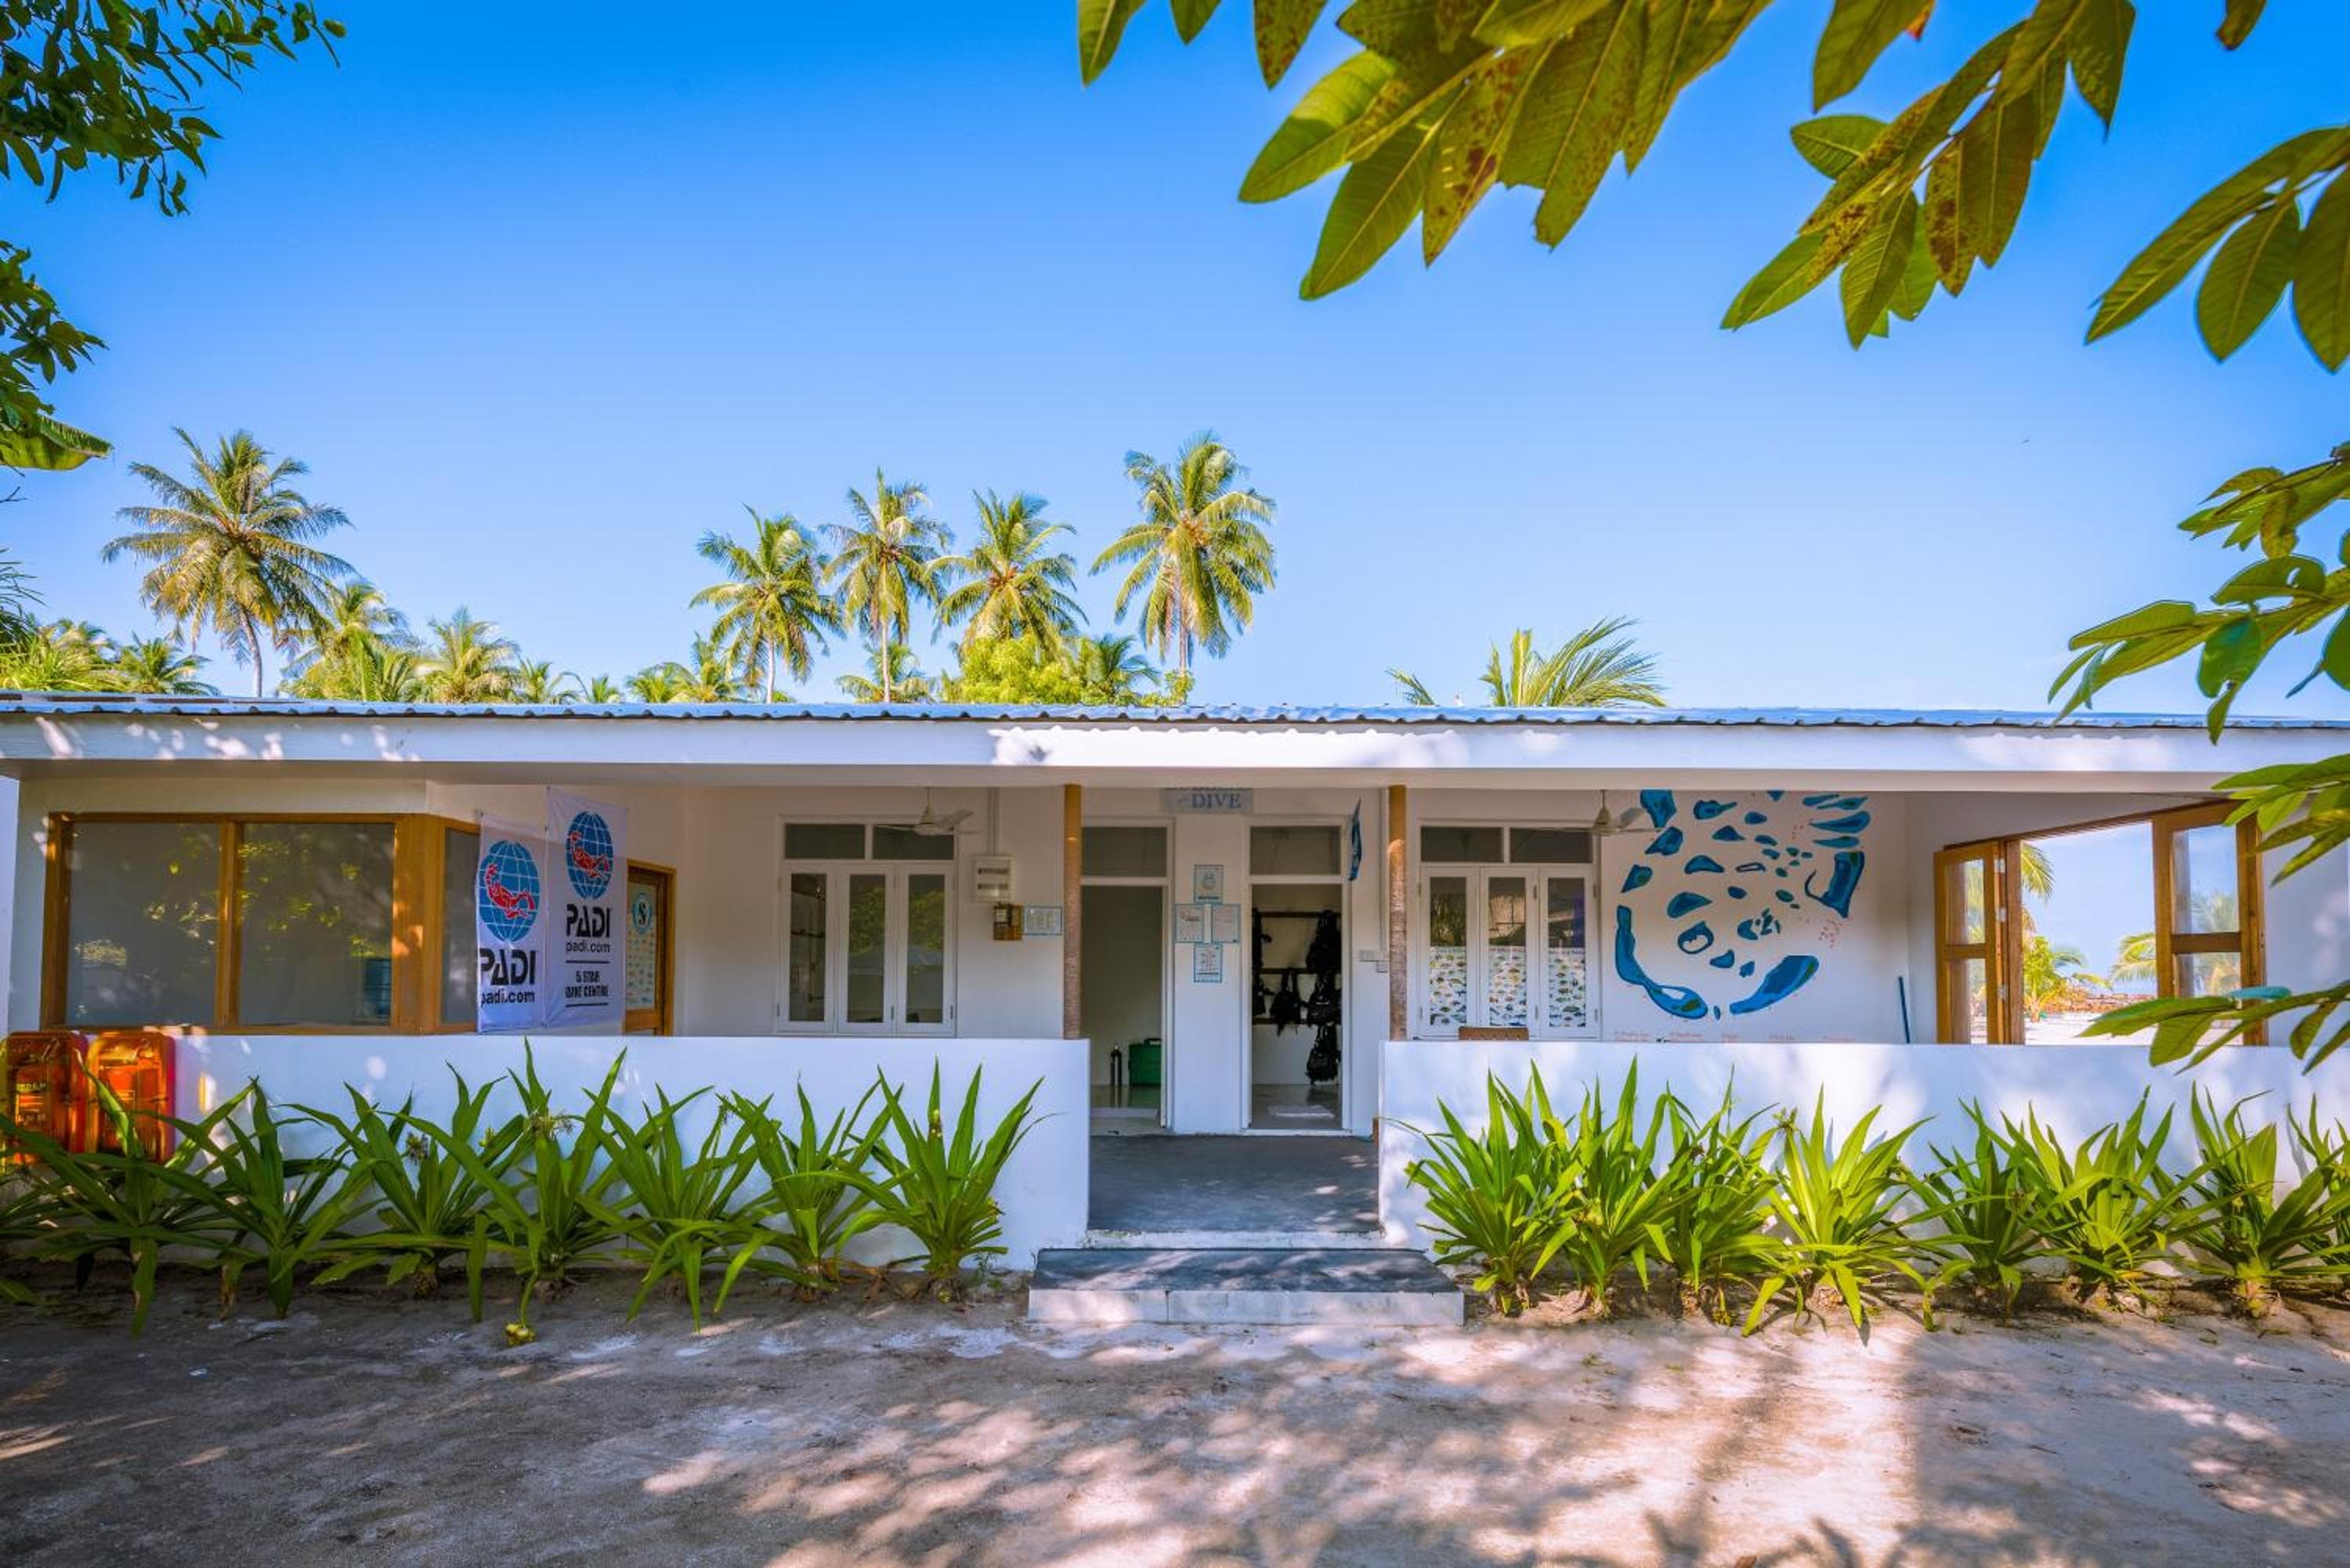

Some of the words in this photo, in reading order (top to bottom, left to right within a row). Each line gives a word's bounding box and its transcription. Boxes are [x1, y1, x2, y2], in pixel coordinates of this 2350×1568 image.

[1191, 793, 1241, 809] DIVE
[566, 903, 610, 938] PADI
[566, 940, 610, 955] padi.com
[479, 948, 536, 985] PADI
